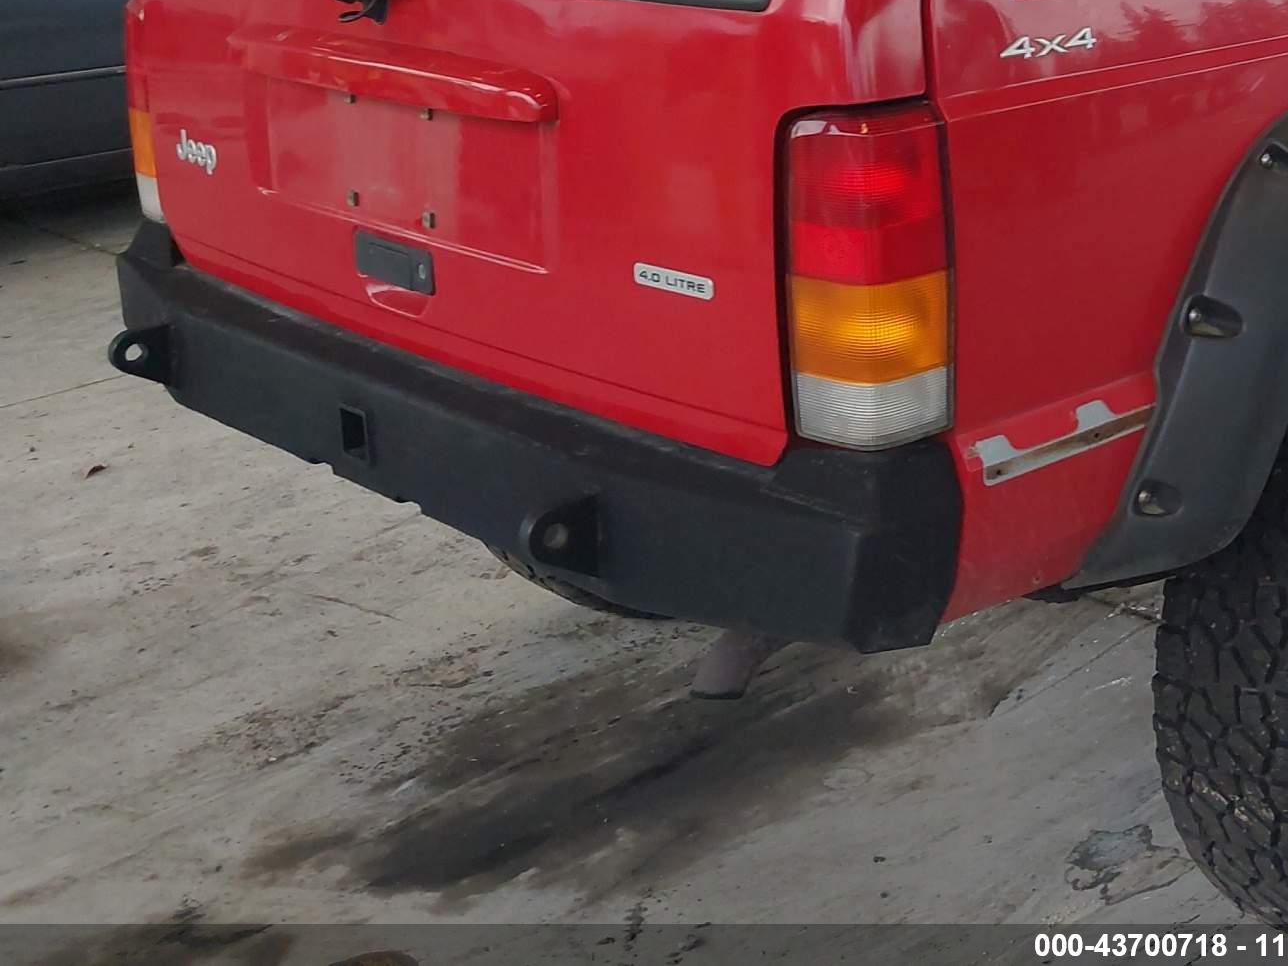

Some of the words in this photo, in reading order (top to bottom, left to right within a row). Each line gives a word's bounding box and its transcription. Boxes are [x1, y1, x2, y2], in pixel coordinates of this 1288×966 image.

[176, 128, 217, 175] Jeep
[639, 270, 661, 283] 4.0
[665, 275, 706, 293] LITRE
